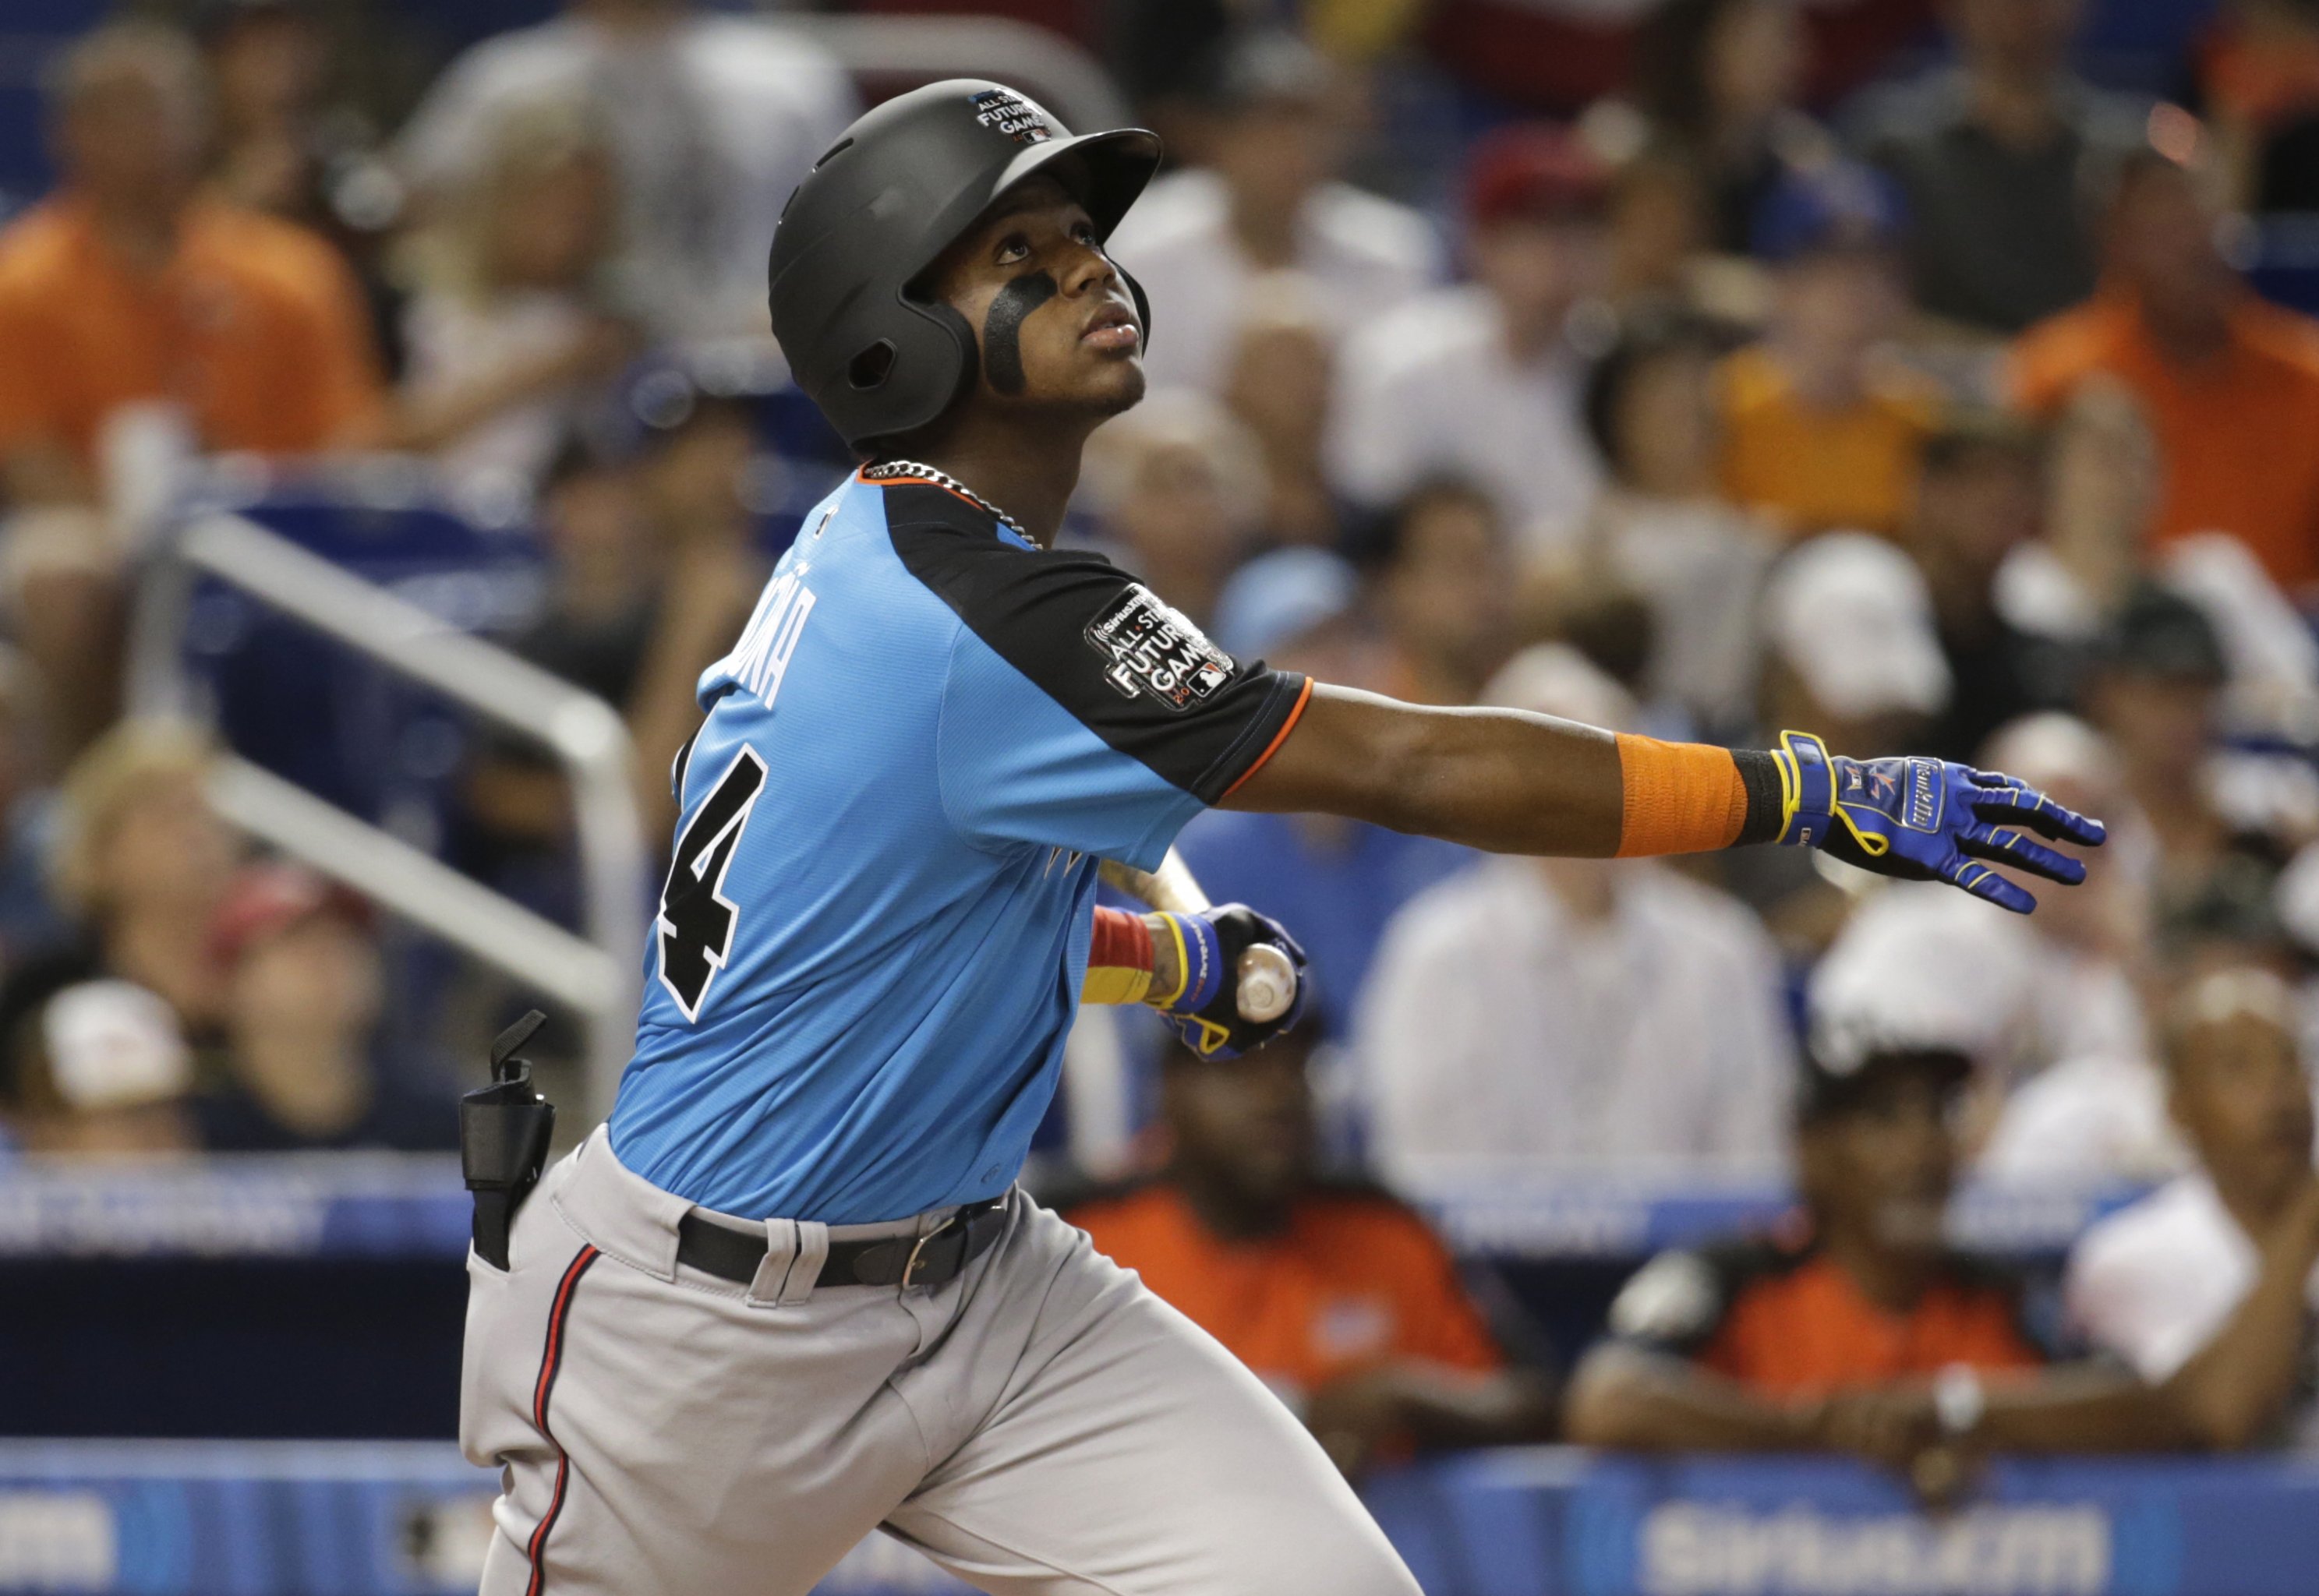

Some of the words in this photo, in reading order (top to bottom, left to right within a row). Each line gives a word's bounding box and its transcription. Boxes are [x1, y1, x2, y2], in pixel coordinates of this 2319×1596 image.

[978, 99, 1000, 111] ALL
[998, 94, 1020, 104] STA
[999, 115, 1045, 134] GAME
[1110, 630, 1144, 660] ALL
[1112, 621, 1185, 691] FUTUR
[1911, 759, 1938, 826] Franklin
